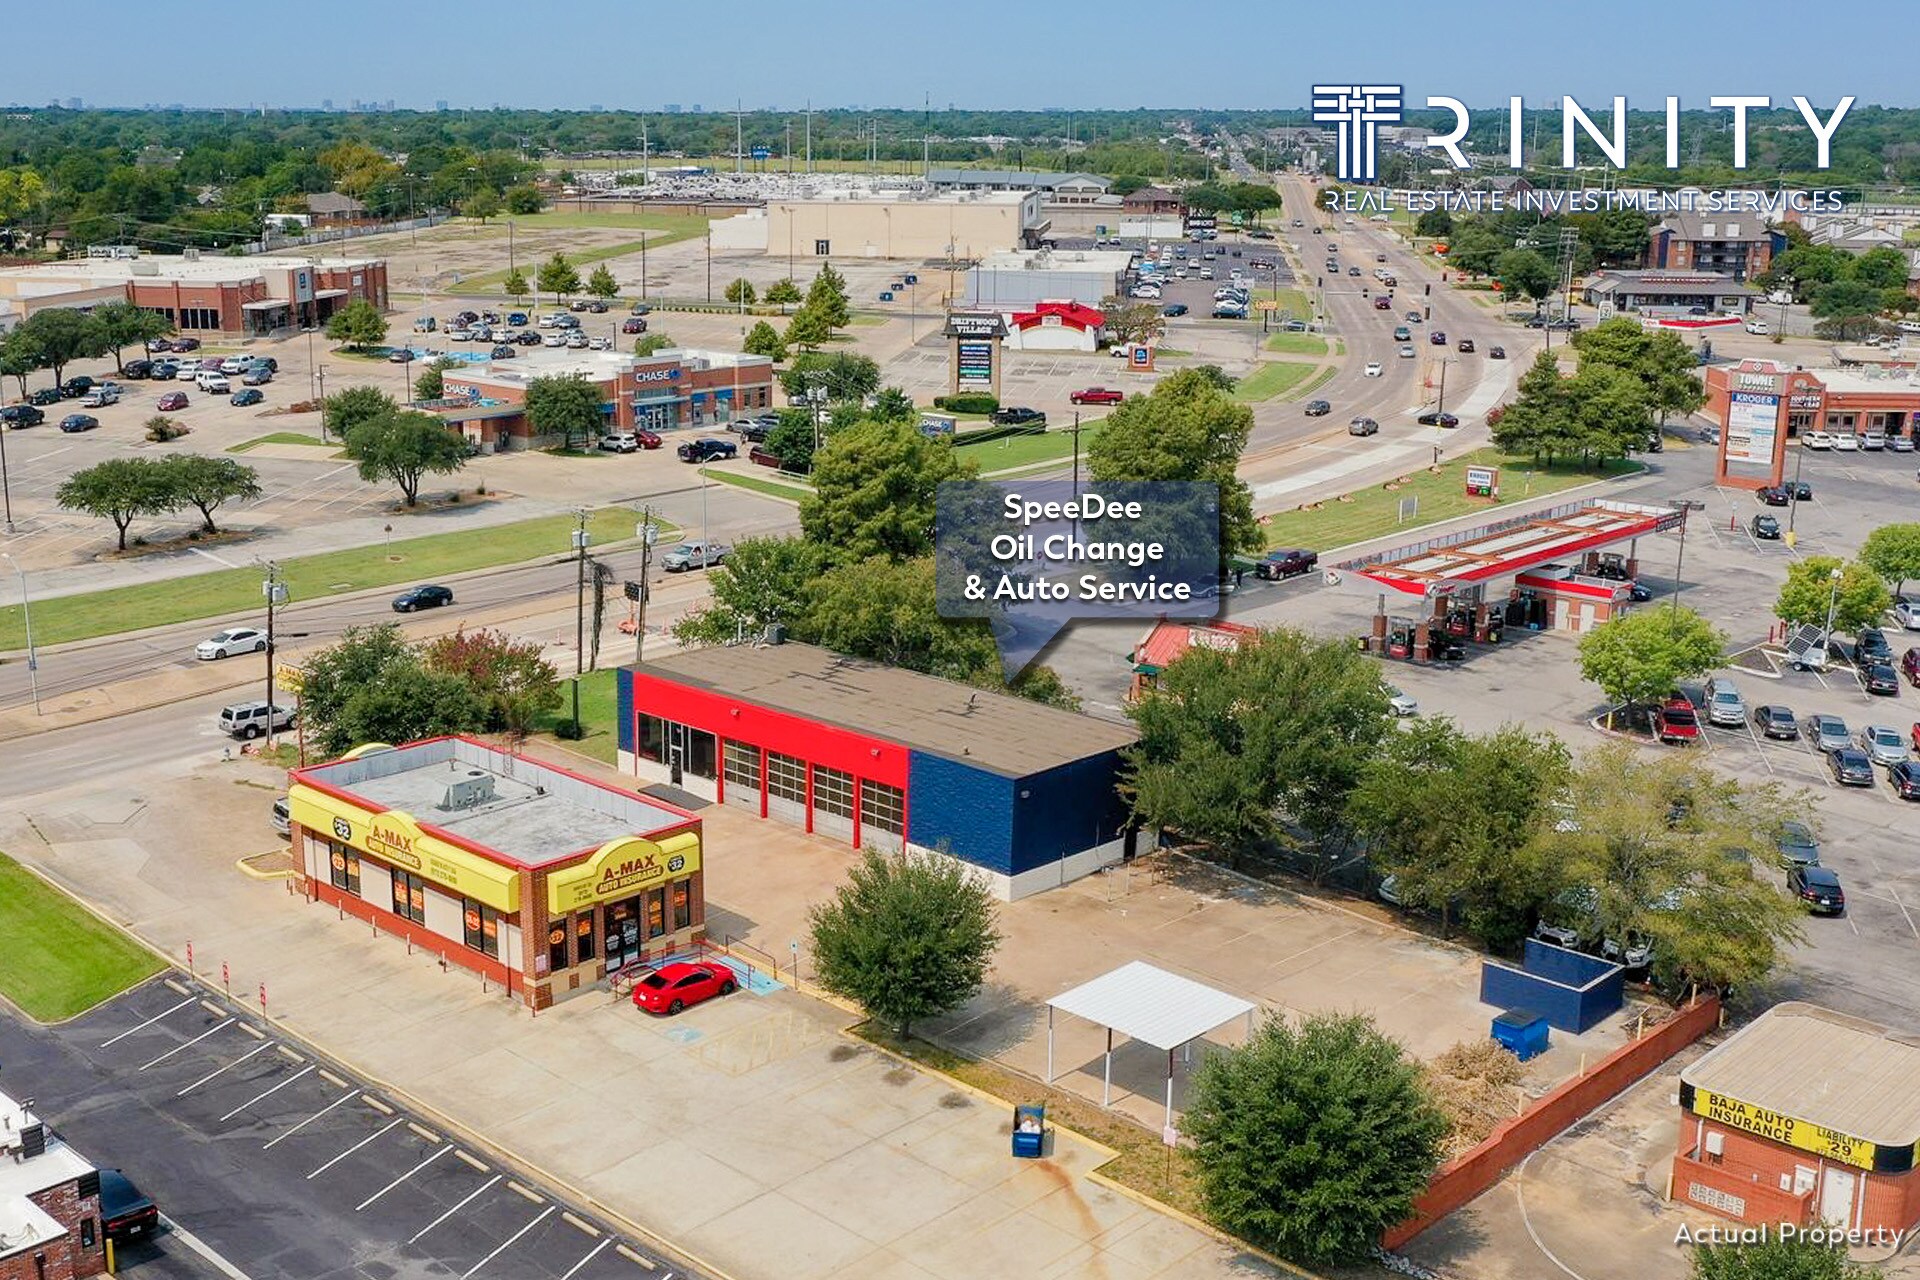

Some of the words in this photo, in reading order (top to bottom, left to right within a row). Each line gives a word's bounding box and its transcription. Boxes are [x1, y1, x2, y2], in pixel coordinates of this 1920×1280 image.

[443, 382, 471, 397] CHASE
[636, 369, 670, 383] CHASE
[1735, 391, 1774, 405] KROGER
[372, 824, 413, 853] A-MAX
[597, 878, 619, 894] AUTO
[619, 866, 662, 887] INSURANCE
[602, 854, 656, 881] A-MAX
[1708, 1093, 1746, 1115] BAJA
[1754, 1108, 1796, 1131] AUTO
[1708, 1106, 1794, 1143] INSURANCE
[1816, 1126, 1865, 1150] LIABILITY
